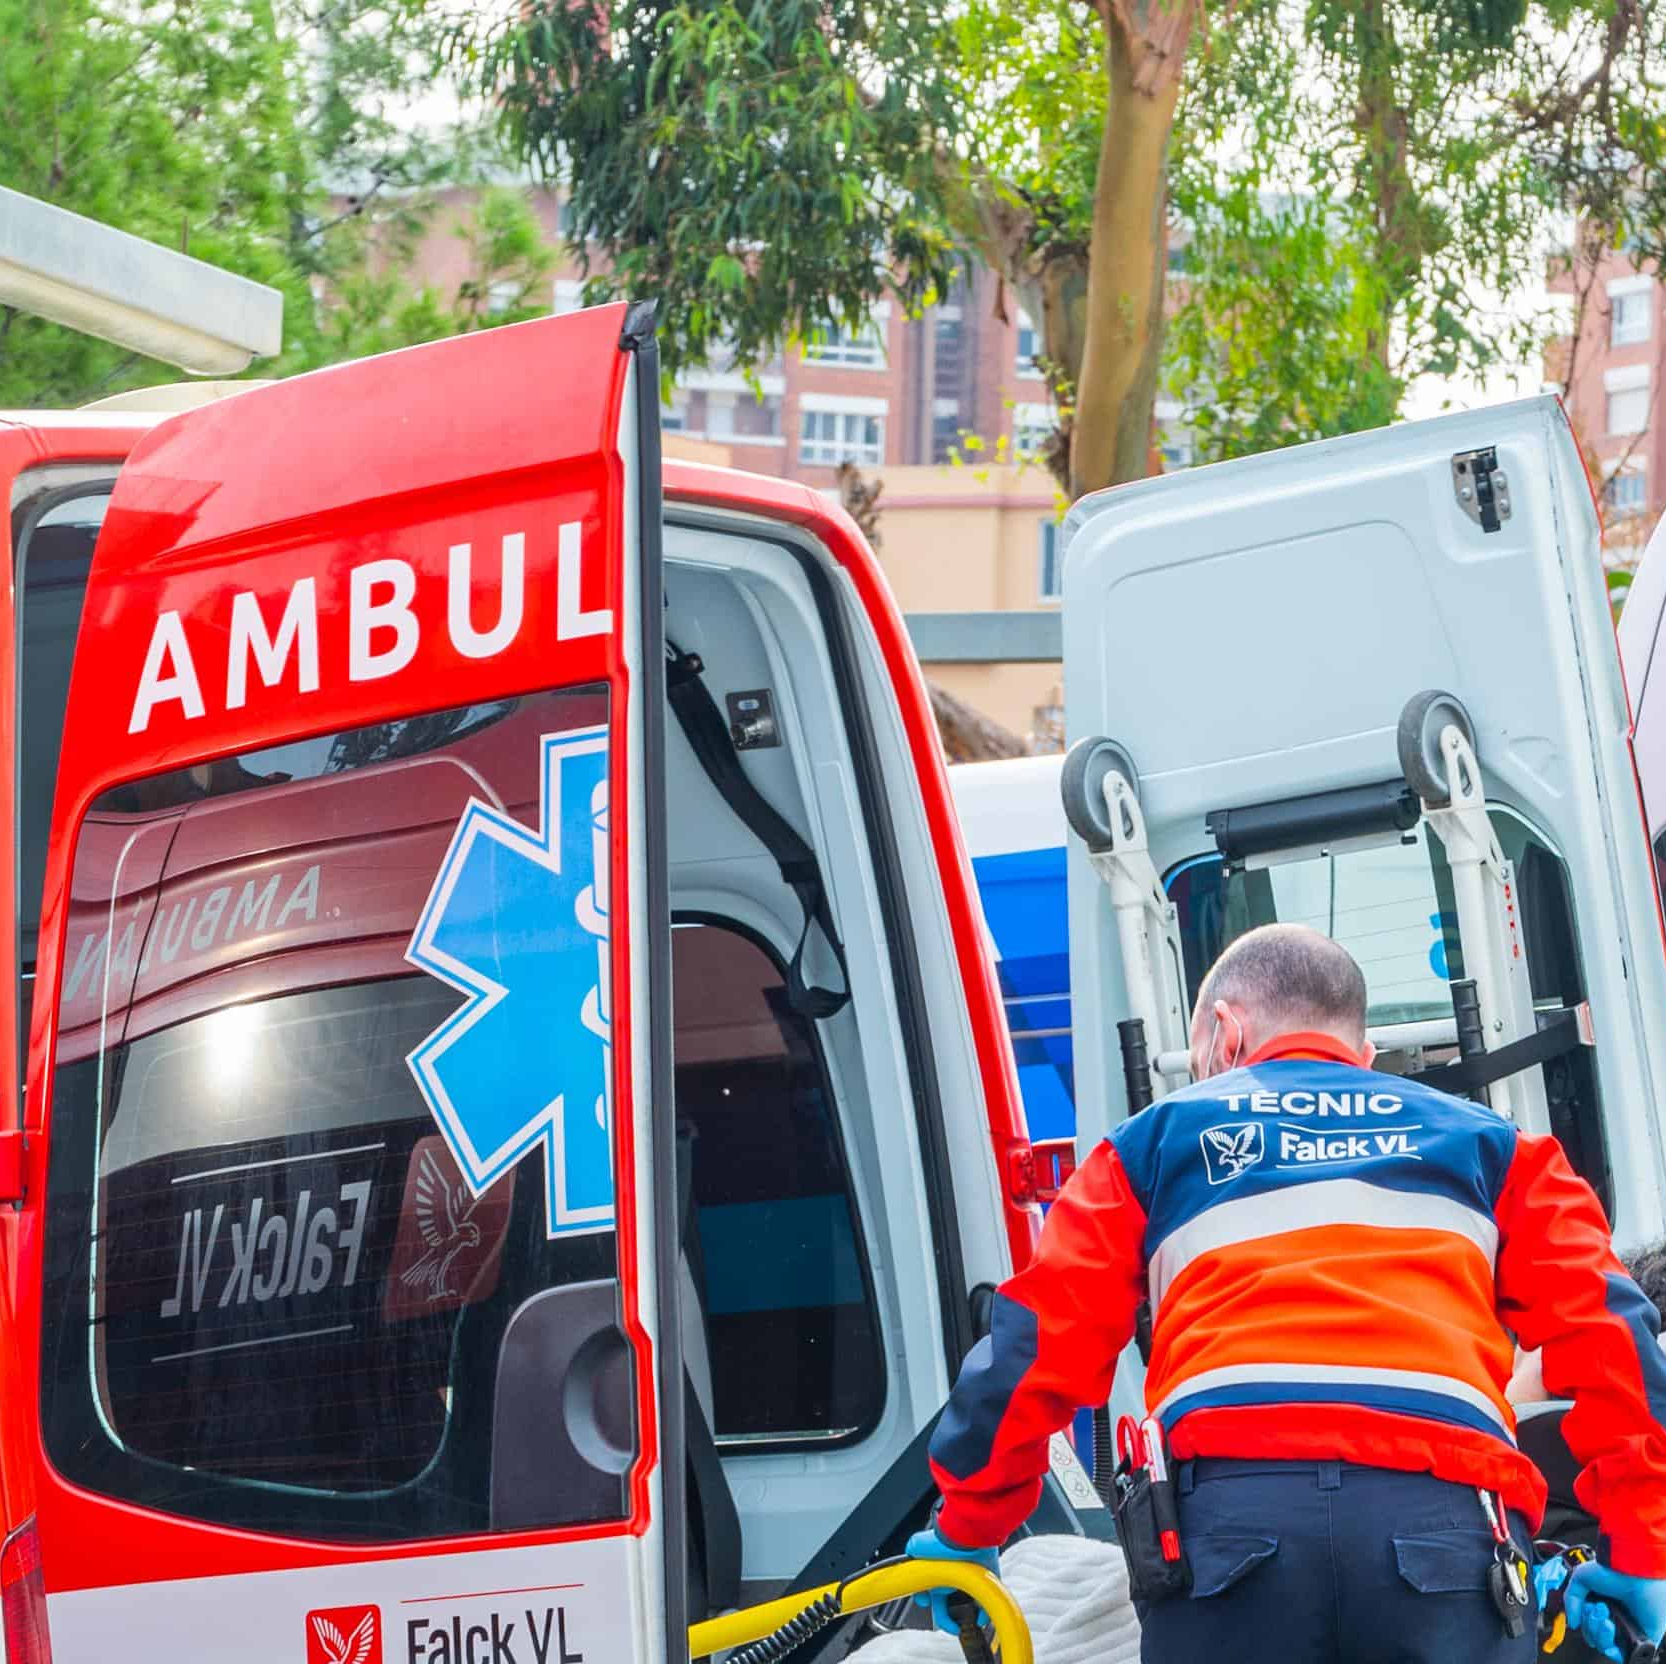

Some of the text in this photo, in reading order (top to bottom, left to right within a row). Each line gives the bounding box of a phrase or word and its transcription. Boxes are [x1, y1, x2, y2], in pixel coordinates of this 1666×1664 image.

[127, 521, 613, 735] AMBUL
[1278, 1131, 1418, 1162] Falck VL
